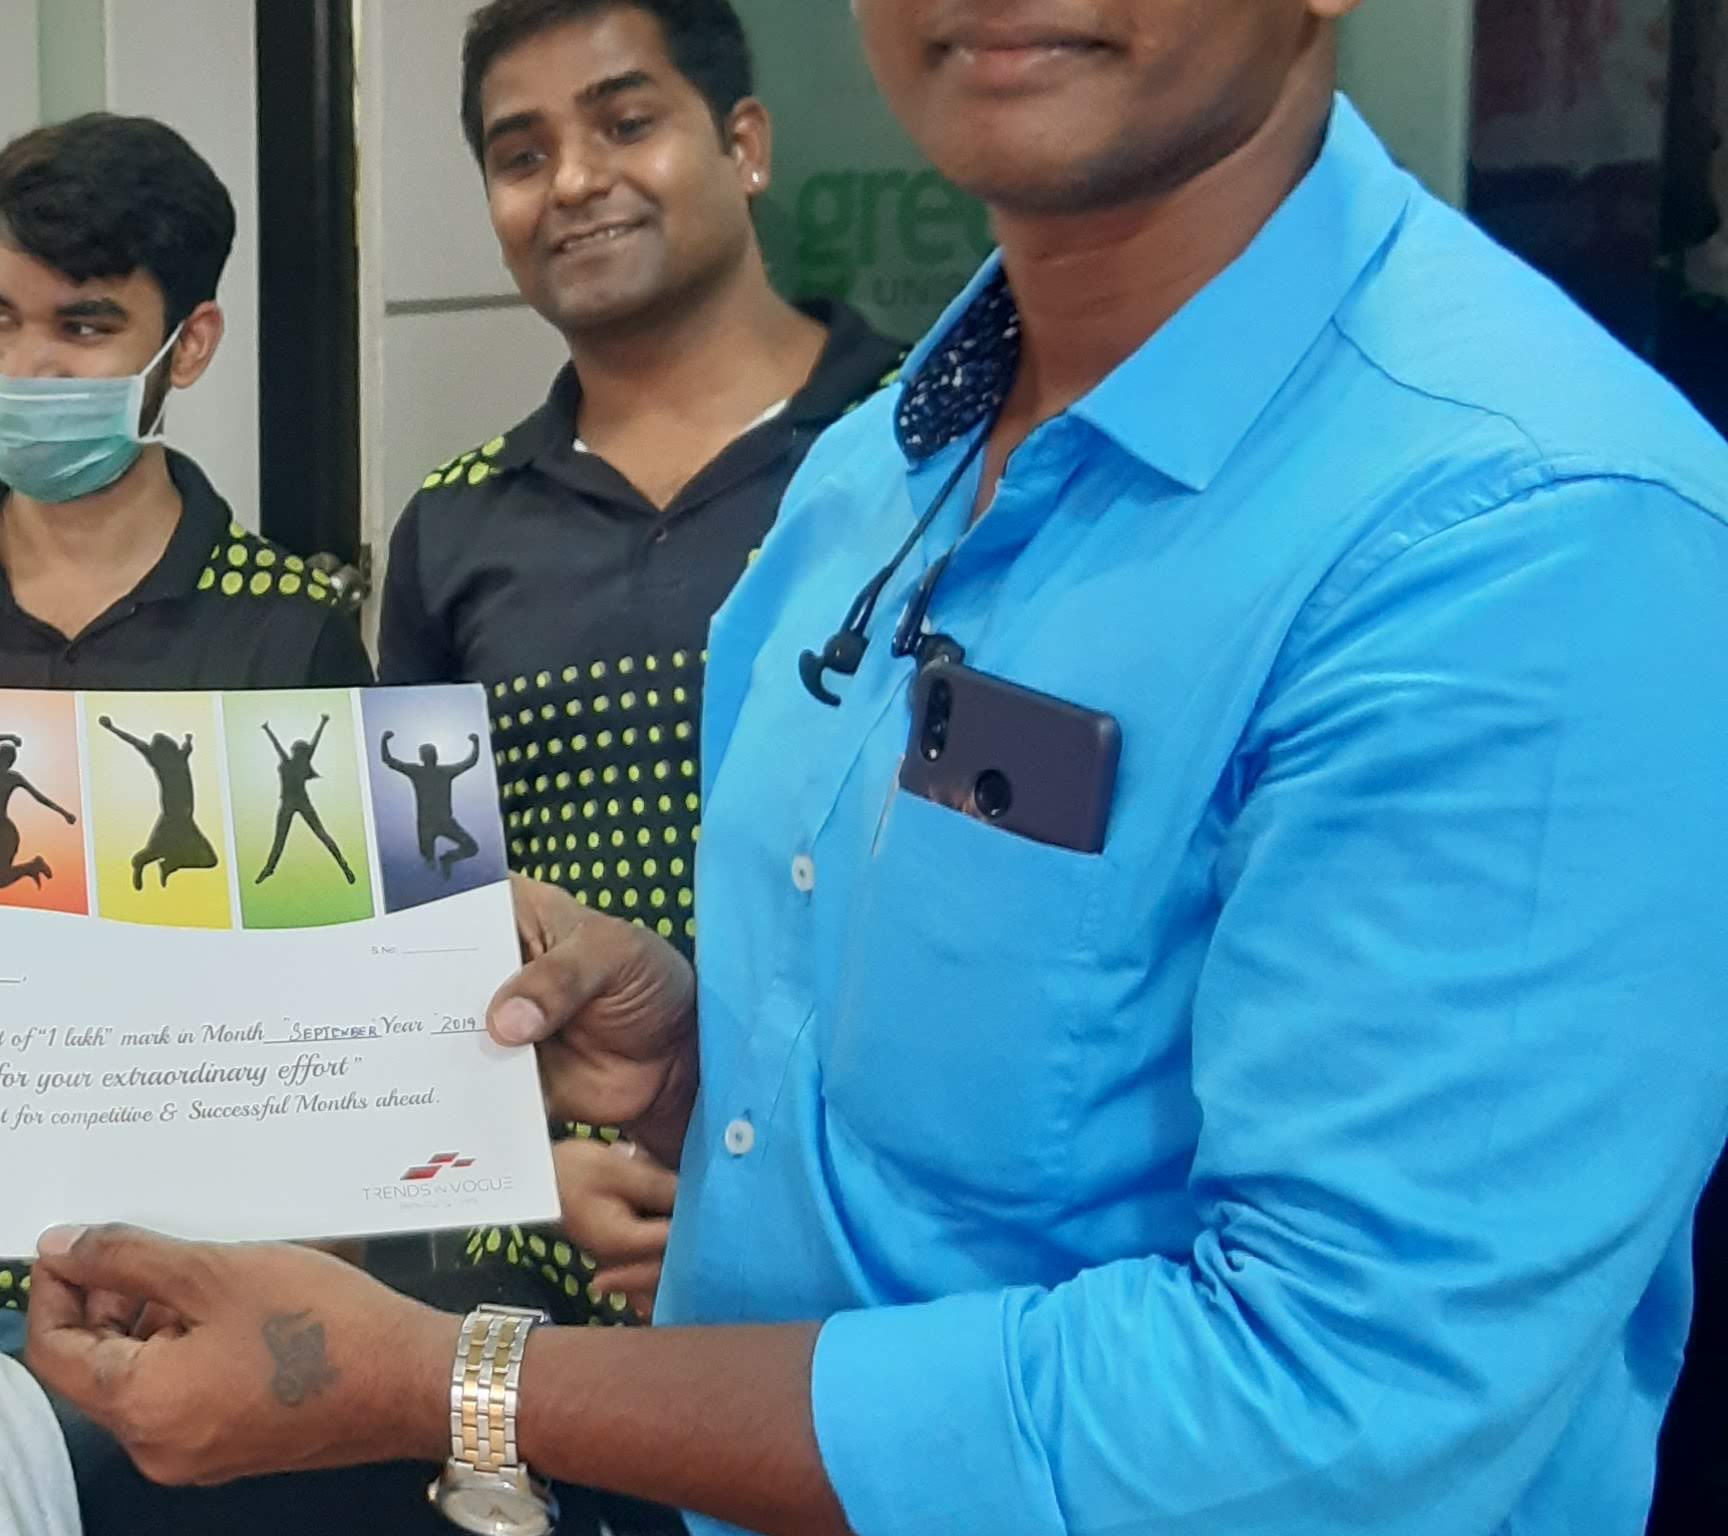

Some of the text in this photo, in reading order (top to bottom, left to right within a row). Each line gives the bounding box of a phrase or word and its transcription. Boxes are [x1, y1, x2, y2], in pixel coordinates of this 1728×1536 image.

[796, 167, 993, 298] gre
[120, 1025, 170, 1047] mark
[176, 1028, 196, 1043] in
[200, 1021, 265, 1043] Month
[380, 1015, 424, 1034] Year
[36, 1071, 94, 1094] your
[101, 1064, 268, 1088] extraordinary
[12, 1104, 44, 1130] for
[50, 1105, 153, 1130] competitive
[159, 1103, 178, 1123] &
[188, 1095, 290, 1122] Successful
[294, 1091, 370, 1115] Months
[362, 1183, 432, 1200] TRENDS
[449, 1176, 513, 1194] VOGUE
